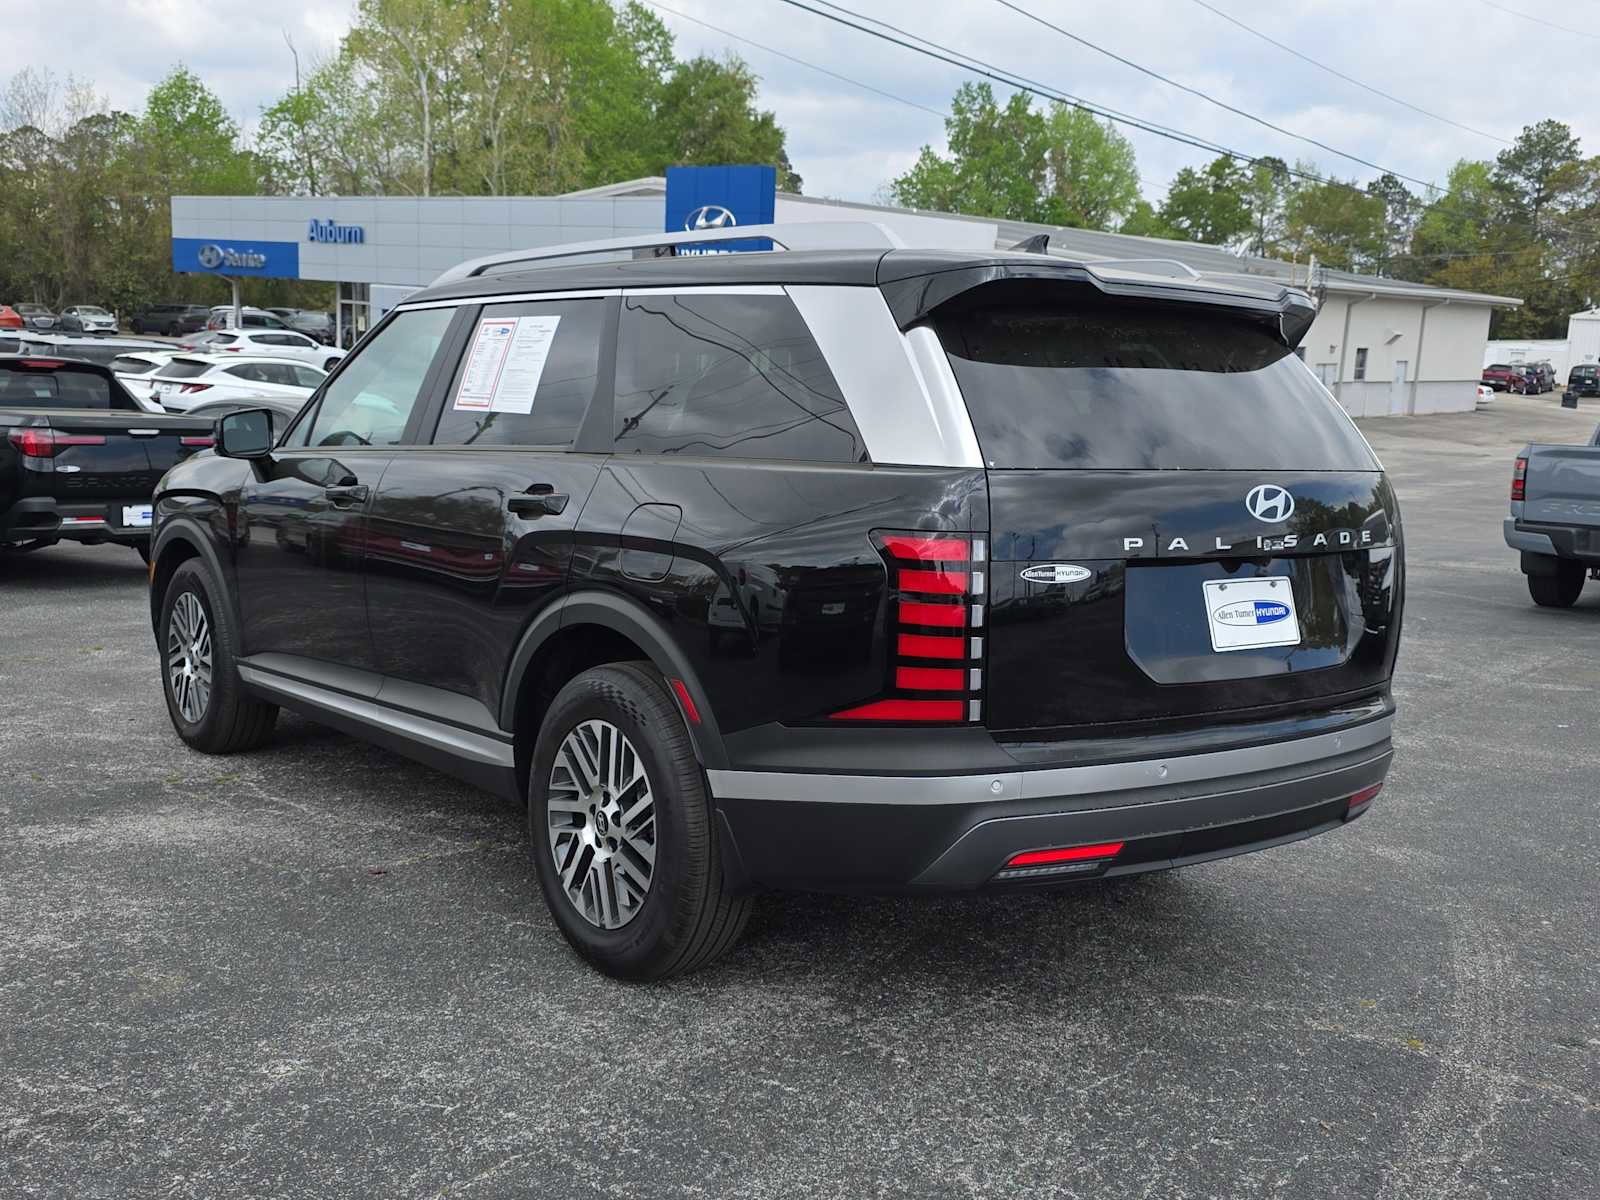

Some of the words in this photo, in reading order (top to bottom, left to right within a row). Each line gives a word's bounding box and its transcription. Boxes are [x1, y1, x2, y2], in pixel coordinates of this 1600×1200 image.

[308, 218, 364, 244] Auburn
[1123, 530, 1371, 550] PALISADE
[1218, 610, 1234, 620] Allen
[1235, 608, 1255, 618] Turner
[1256, 607, 1287, 617] HYUNDAI
